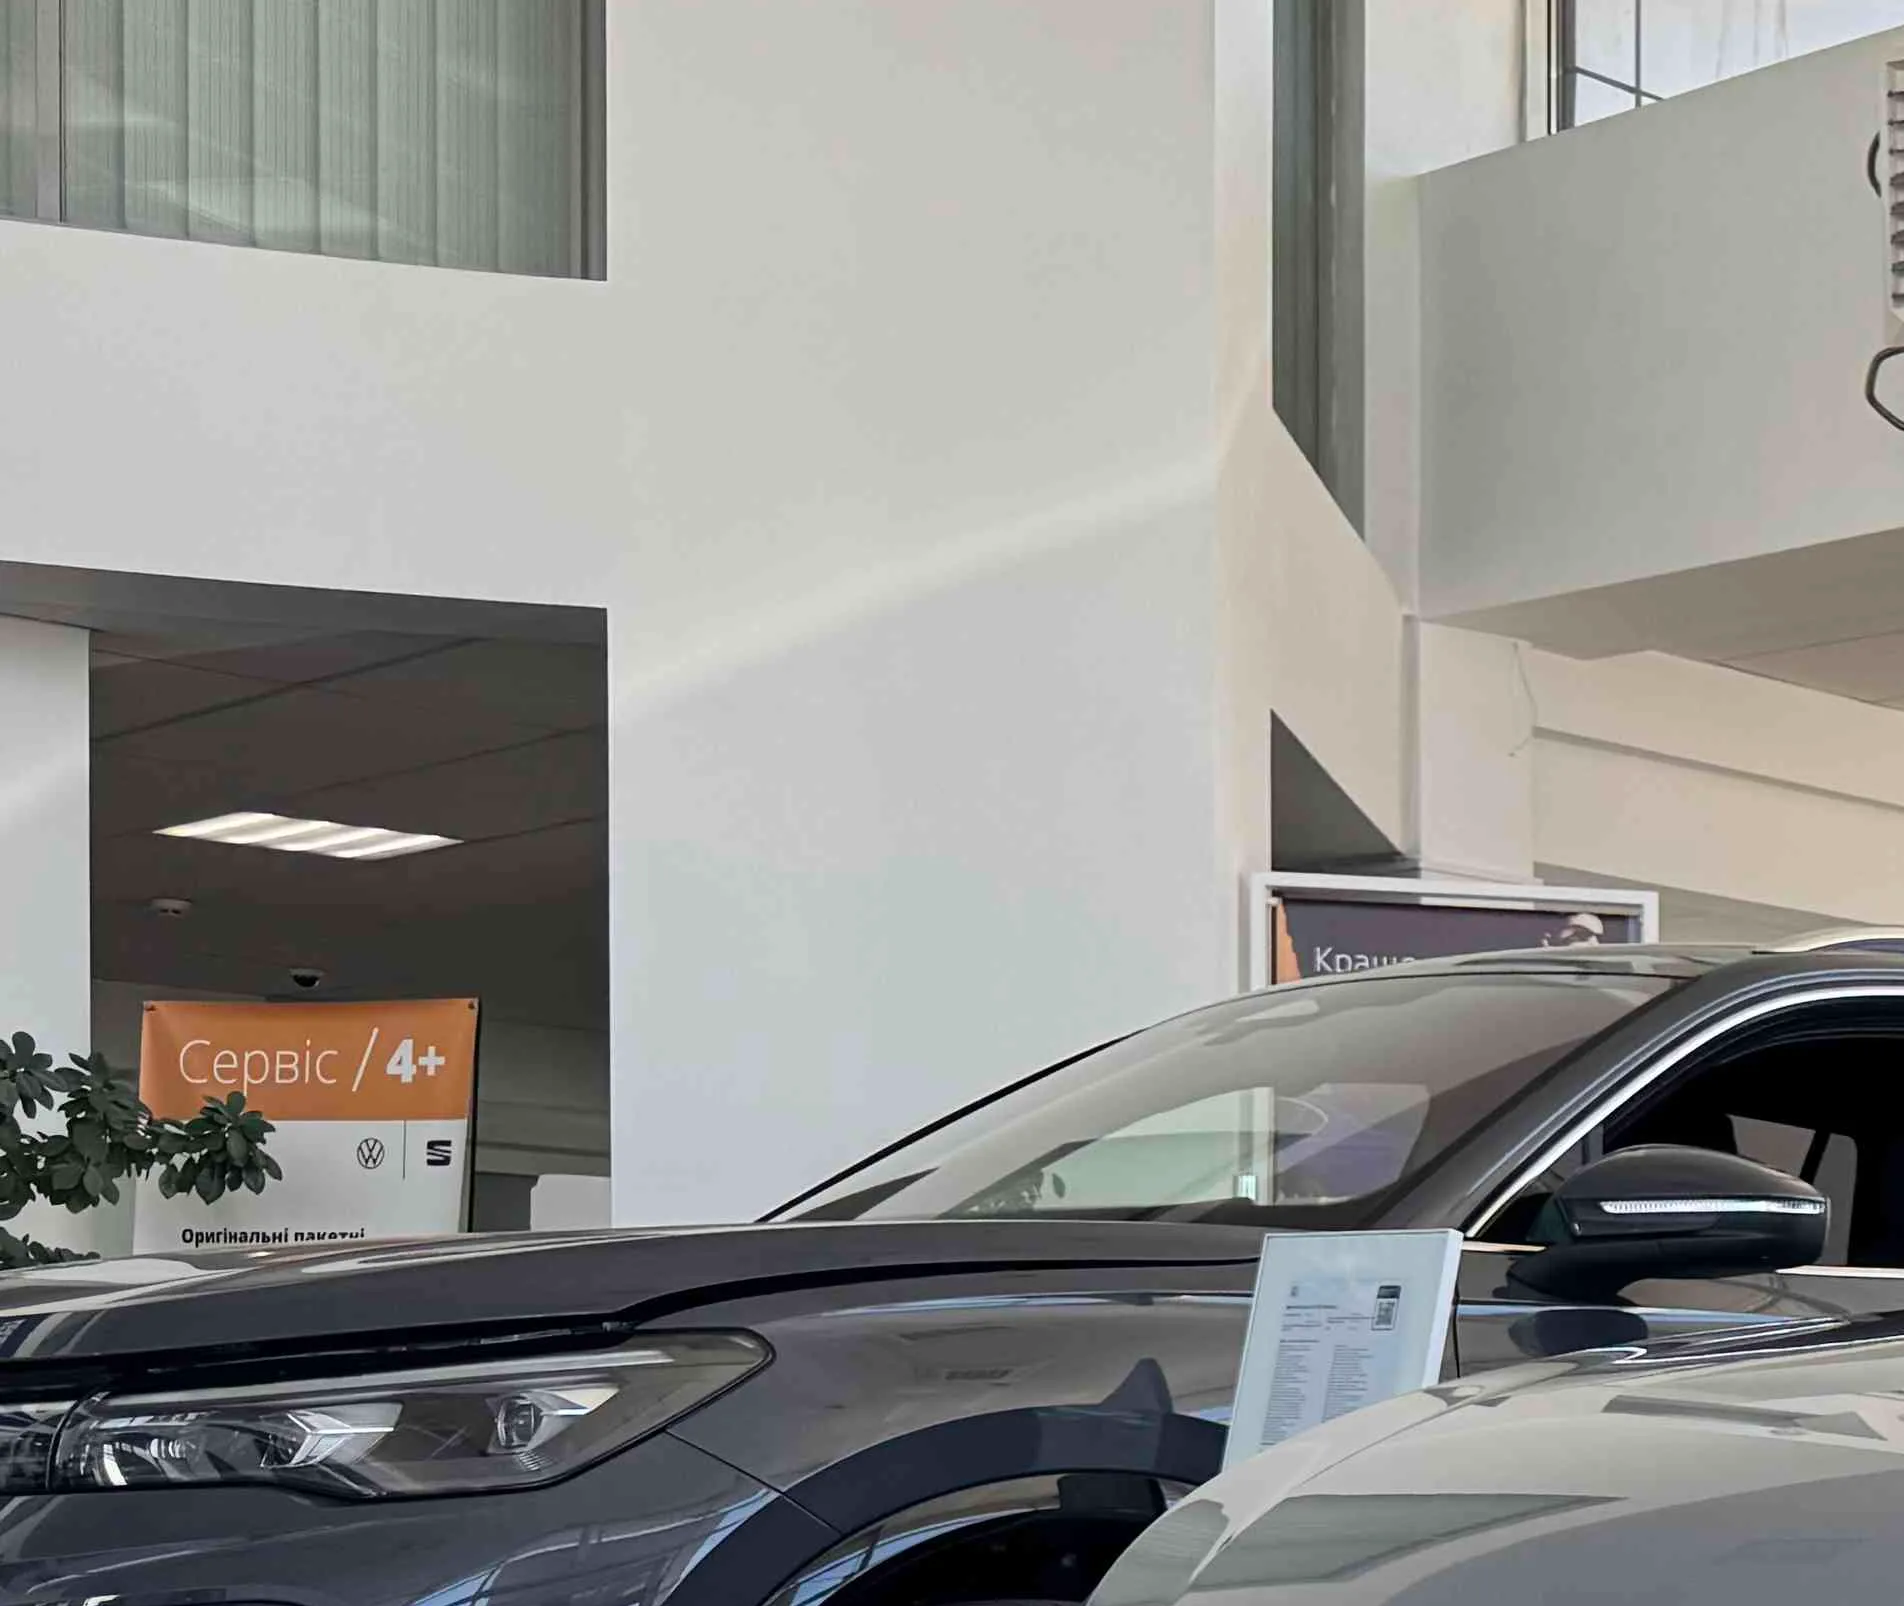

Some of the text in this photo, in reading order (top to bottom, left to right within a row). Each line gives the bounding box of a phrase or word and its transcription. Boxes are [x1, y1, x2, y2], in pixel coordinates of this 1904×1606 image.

[178, 1038, 339, 1097] Сервіс
[385, 1038, 446, 1084] 4+
[181, 1227, 289, 1248] Оригінальні
